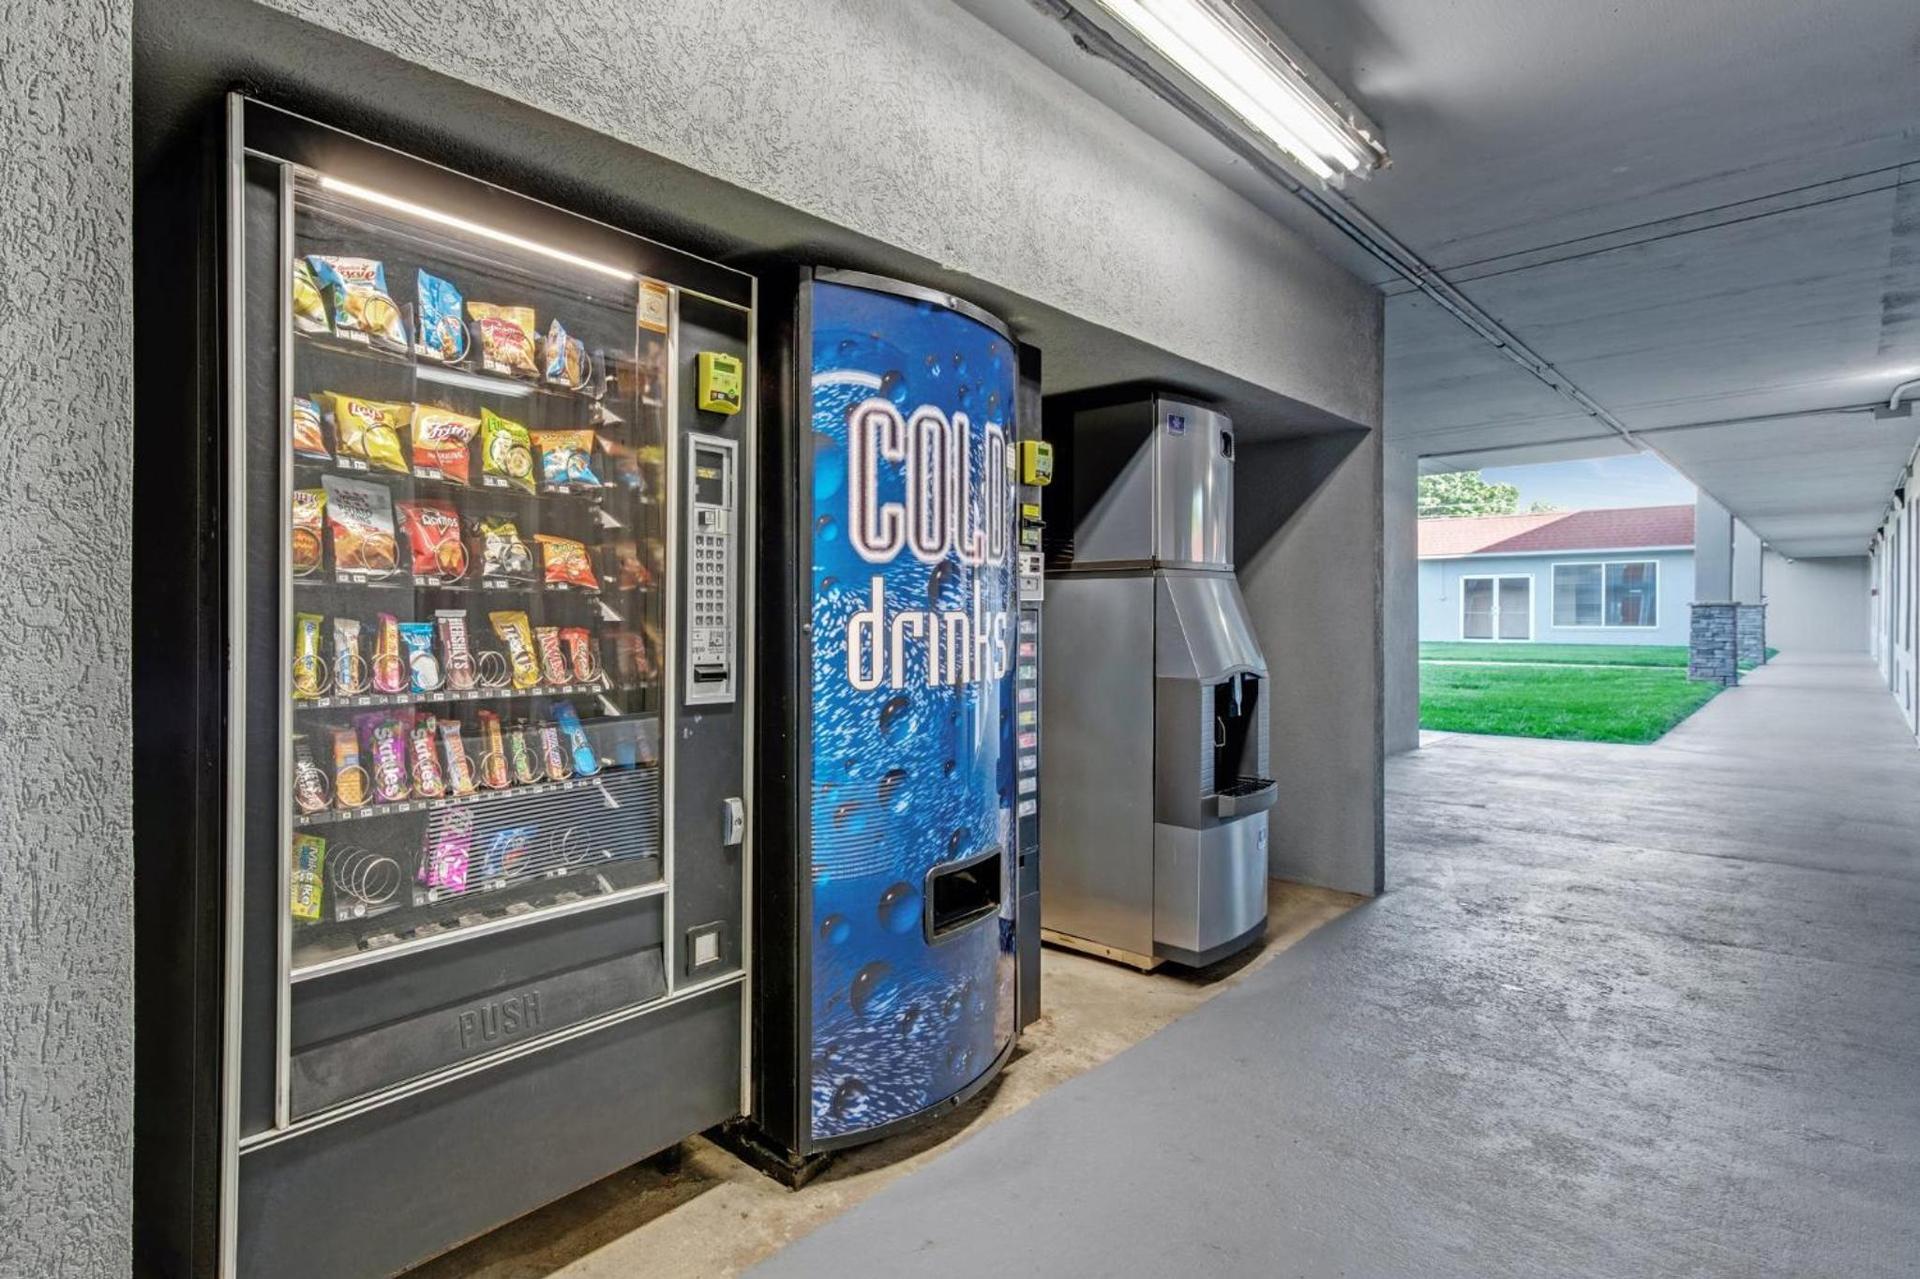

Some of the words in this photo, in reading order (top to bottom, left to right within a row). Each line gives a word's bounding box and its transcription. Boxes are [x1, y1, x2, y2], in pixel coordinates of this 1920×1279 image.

[849, 397, 1006, 563] COLD
[450, 618, 468, 669] HERSHEY'S
[848, 576, 1007, 690] drinks
[374, 727, 399, 796] Skittles
[410, 728, 434, 790] Skittles
[458, 990, 541, 1050] PUSH
